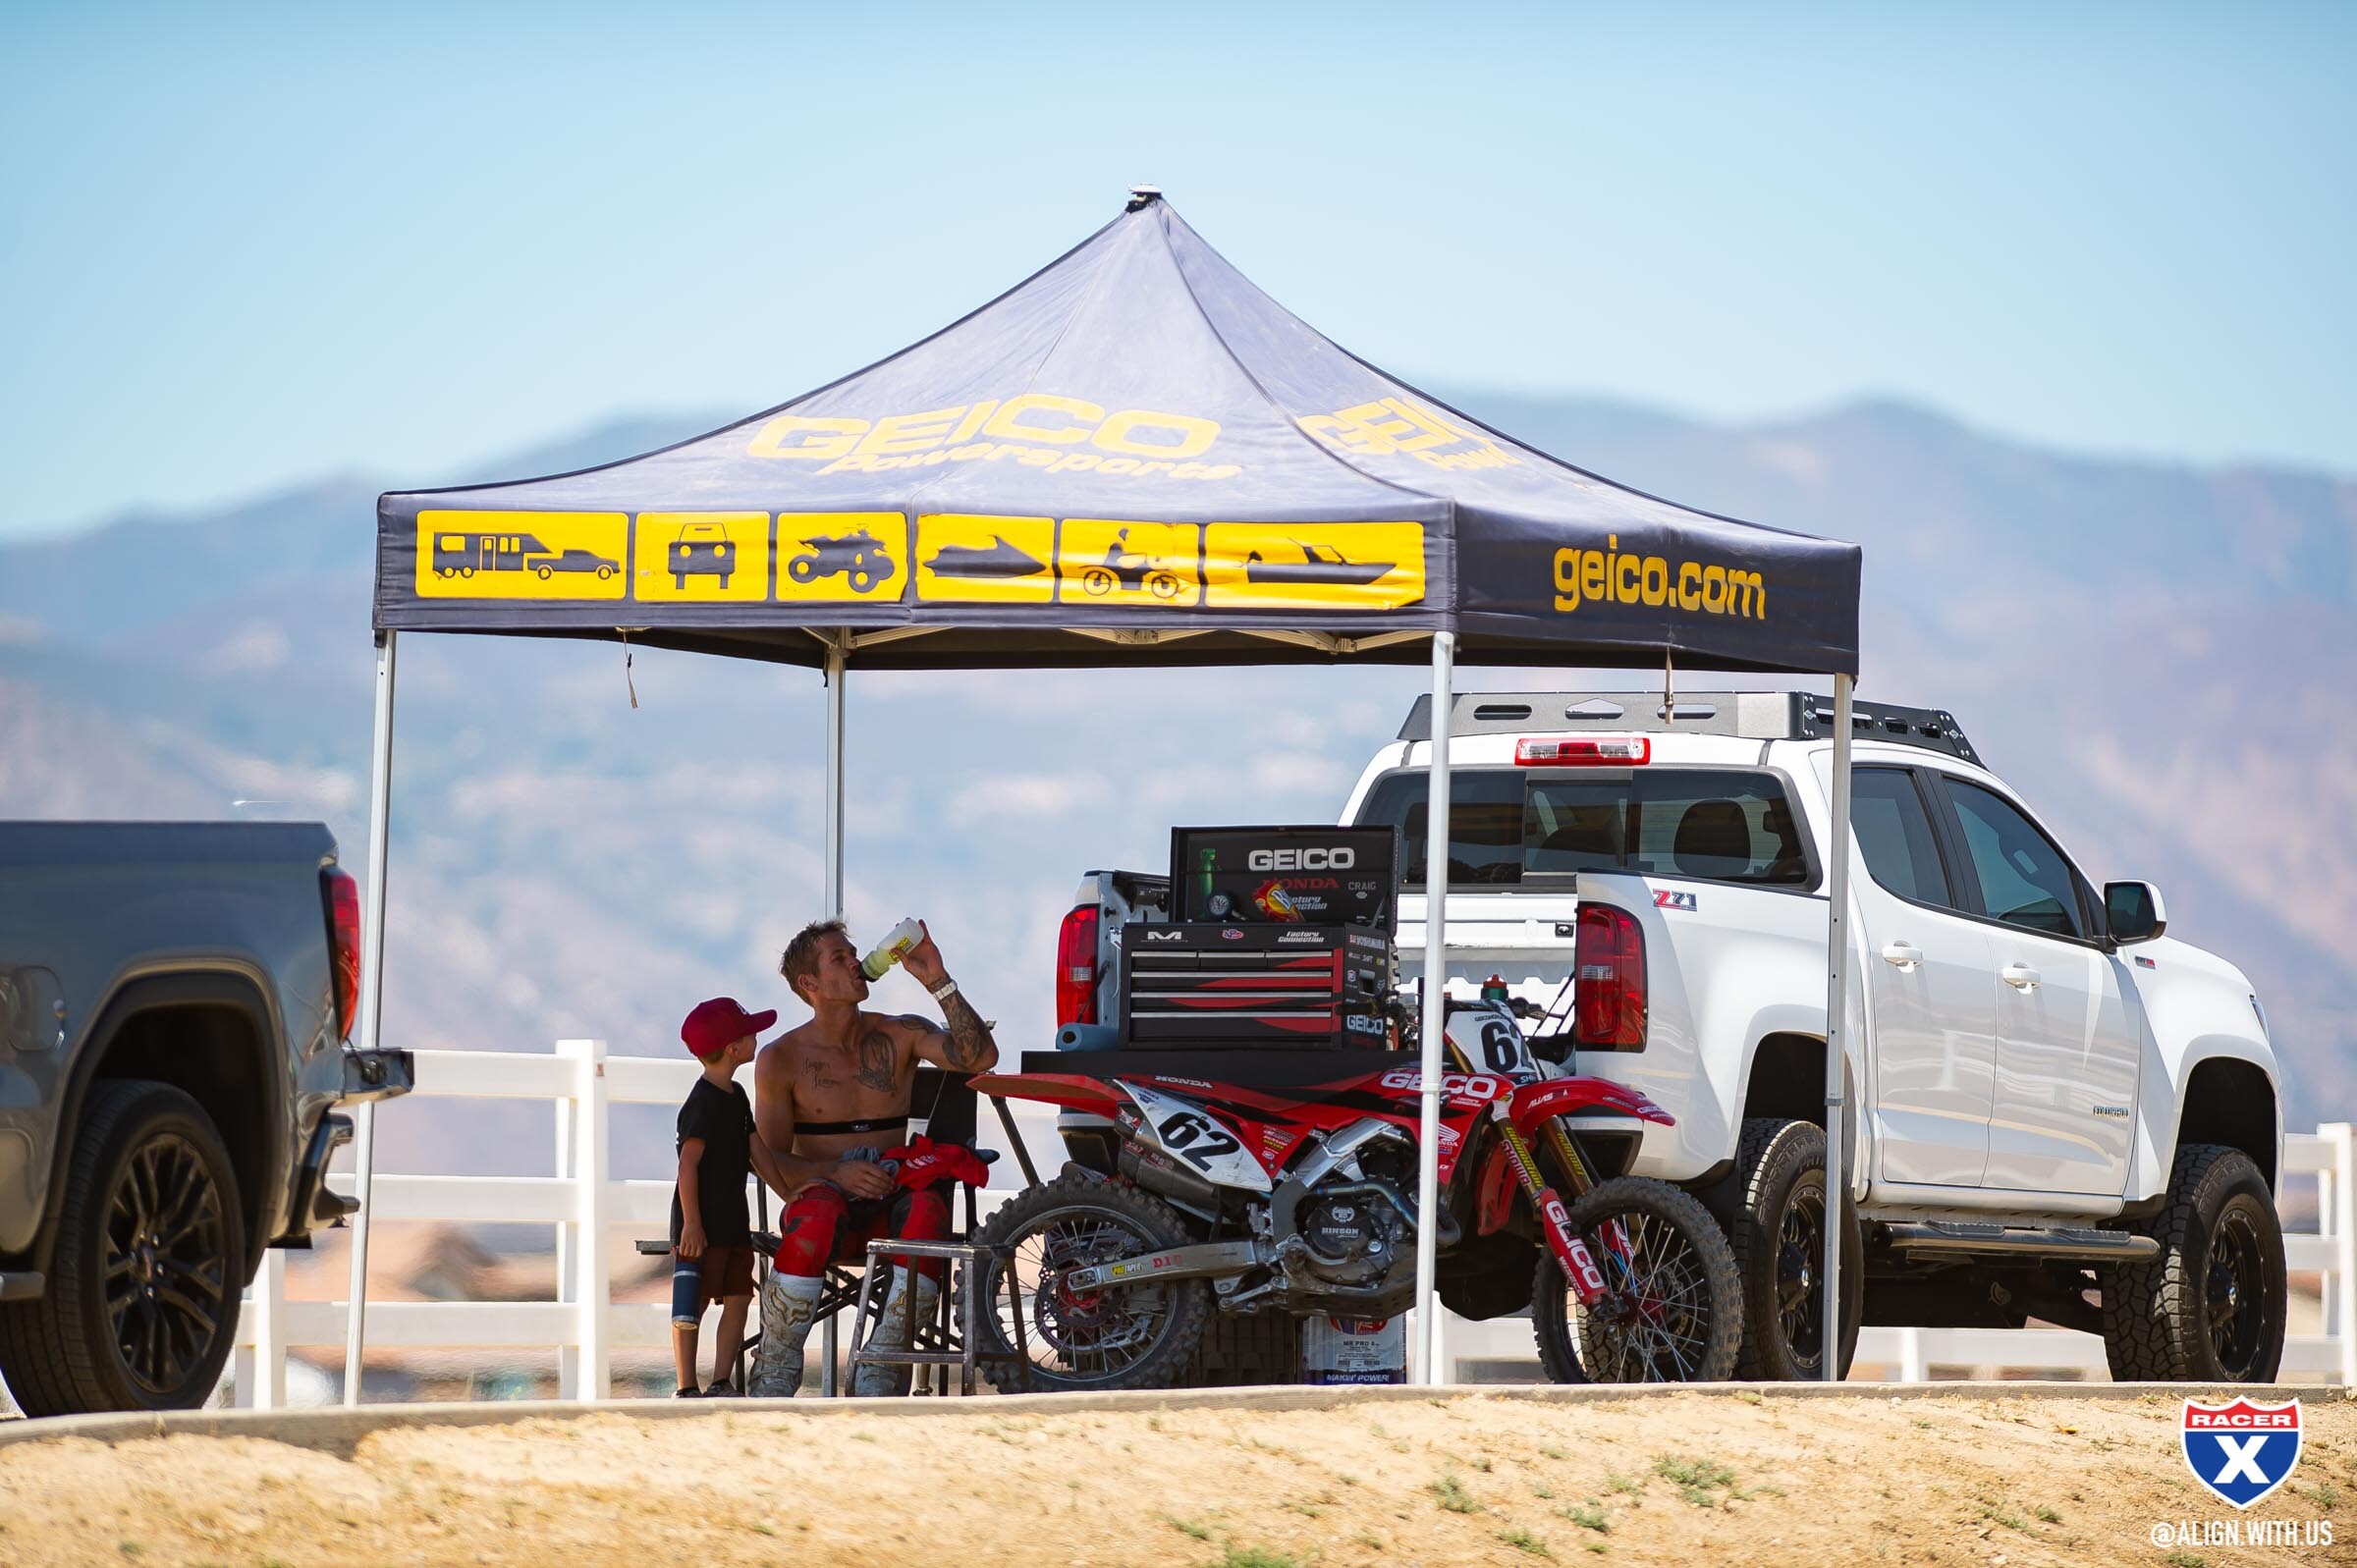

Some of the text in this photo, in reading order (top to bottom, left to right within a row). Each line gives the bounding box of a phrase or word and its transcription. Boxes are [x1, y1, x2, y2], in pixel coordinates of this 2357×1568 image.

[746, 393, 1222, 459] GEICO
[1554, 533, 1766, 620] geico.com
[1248, 847, 1354, 871] GEICO
[1348, 882, 1376, 891] CRAIG
[1653, 888, 1697, 911] Z71
[1155, 1075, 1213, 1089] HONDA
[1381, 1072, 1497, 1099] GECO
[1157, 1111, 1240, 1172] 62
